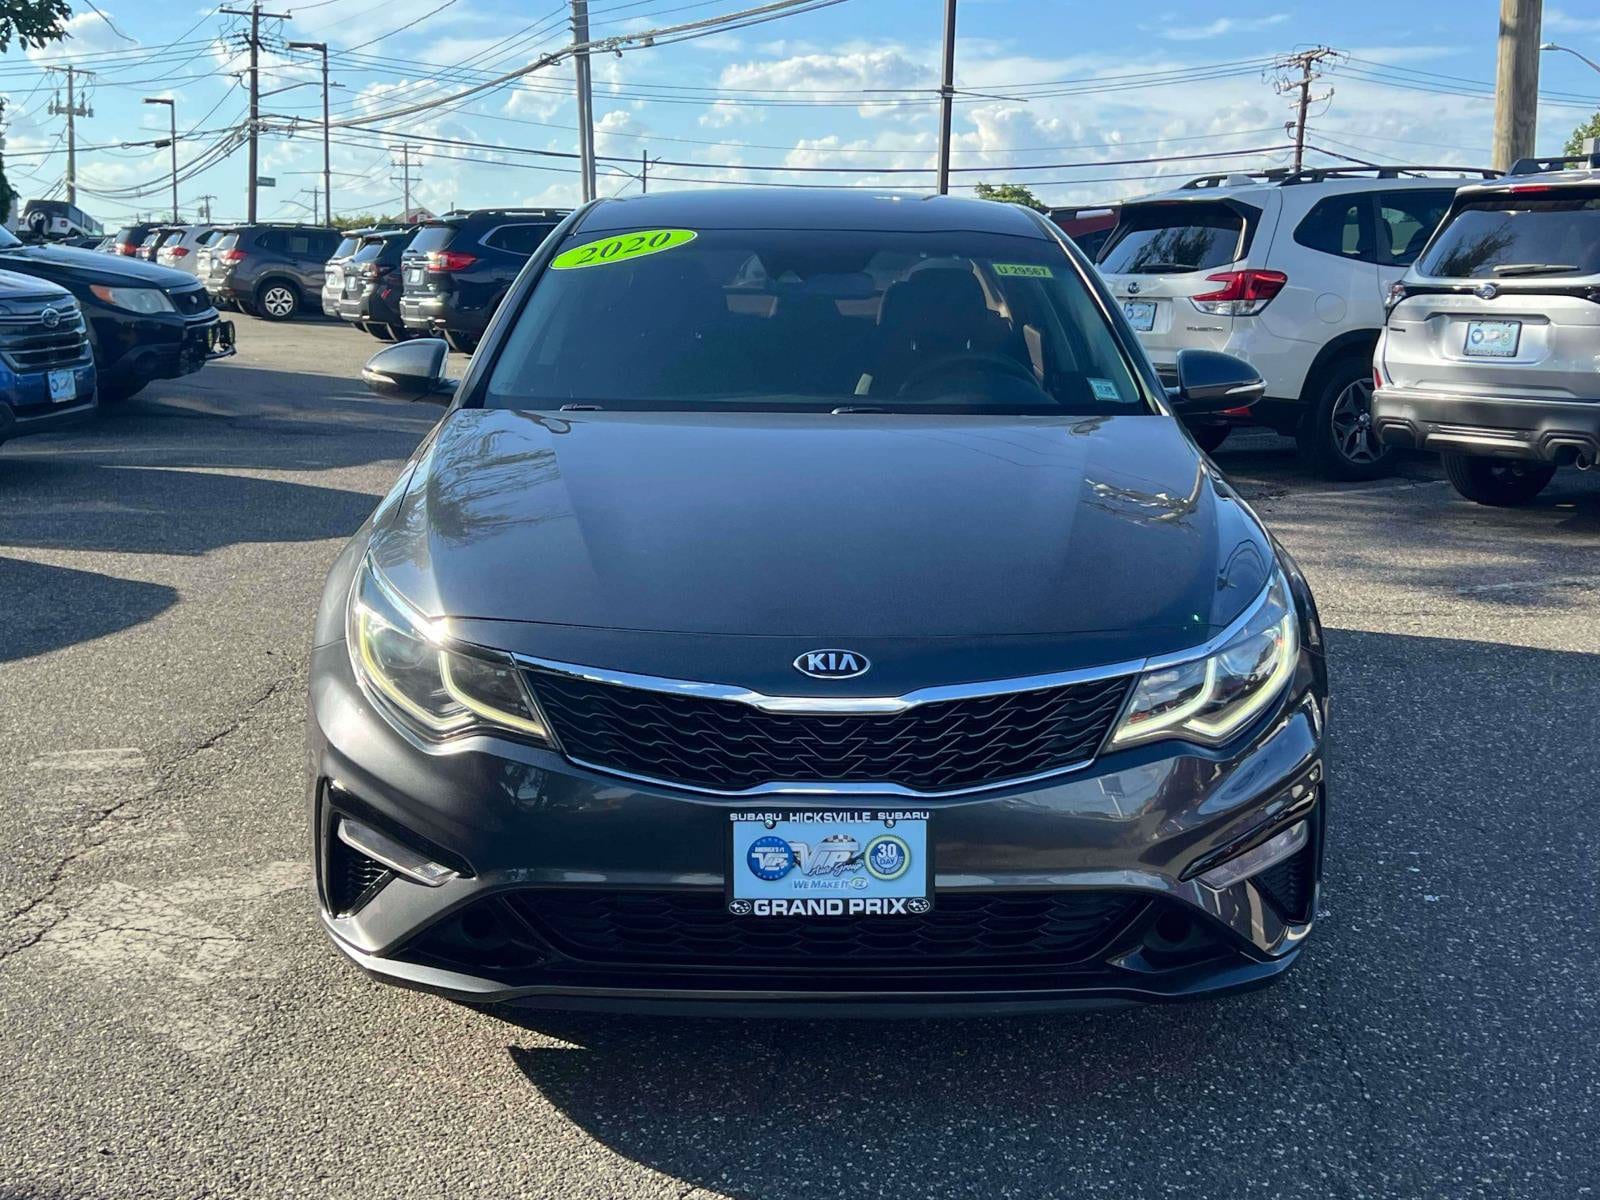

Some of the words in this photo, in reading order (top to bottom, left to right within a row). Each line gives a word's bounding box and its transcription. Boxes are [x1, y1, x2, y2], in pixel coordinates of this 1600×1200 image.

[575, 232, 672, 265] 2020
[807, 653, 858, 671] KIA
[729, 812, 782, 821] SUBARU
[789, 812, 871, 824] HICKSVILLE
[878, 811, 930, 820] SUBARU
[788, 841, 860, 876] VIP
[877, 843, 897, 858] 30
[754, 899, 843, 916] GRAND
[849, 899, 907, 915] PRIX
